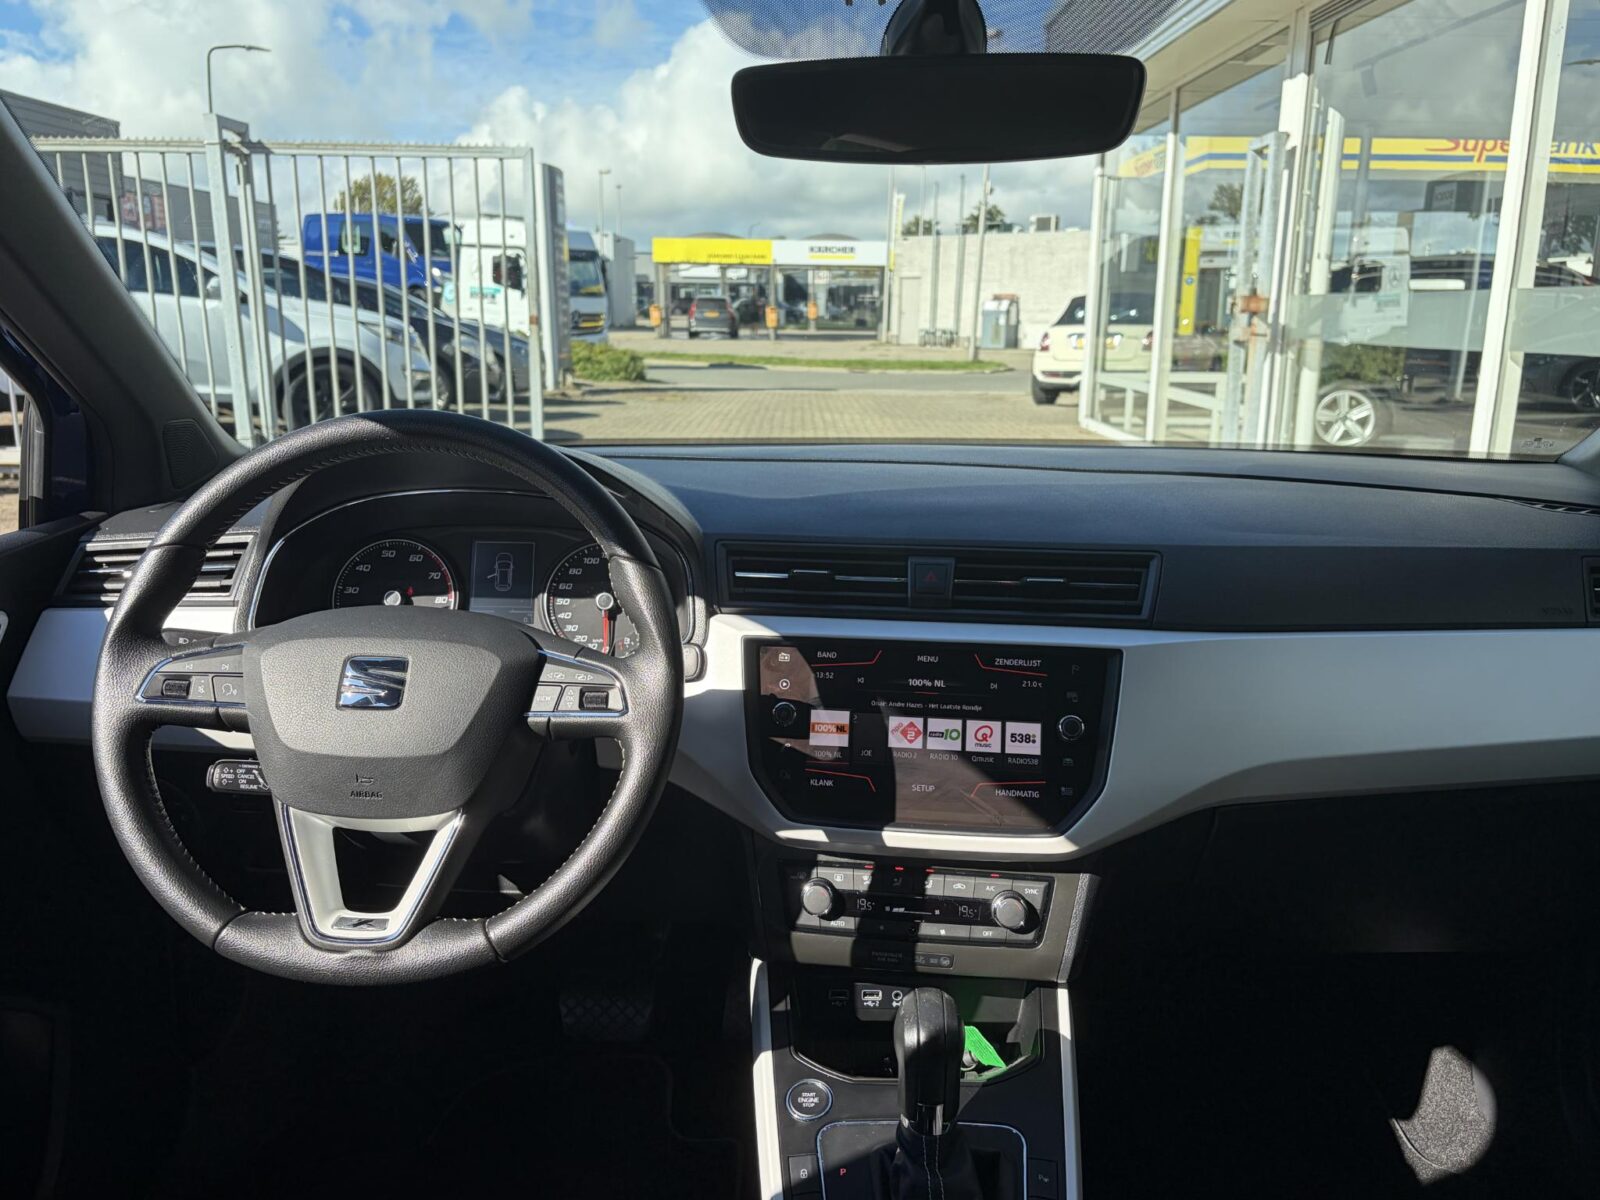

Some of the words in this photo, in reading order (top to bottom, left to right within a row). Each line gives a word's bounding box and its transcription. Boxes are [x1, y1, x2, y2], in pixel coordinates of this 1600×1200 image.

[381, 550, 396, 558] 50
[356, 564, 371, 572] 40
[428, 572, 441, 580] 70
[817, 651, 837, 659] BAND
[917, 655, 939, 663] MENU
[995, 658, 1042, 667] ZENDERLIJST
[816, 672, 834, 680] 13:52
[908, 679, 933, 688] 100%
[934, 680, 946, 688] NL
[944, 729, 960, 741] 10
[861, 749, 873, 757] JOE
[971, 755, 995, 763] Qmusic
[810, 779, 834, 787] KLANK
[912, 784, 935, 792] SETUP
[350, 791, 384, 799] AIRBAG
[995, 789, 1040, 798] HANDMATIG
[830, 920, 845, 928] AUTO
[840, 1168, 847, 1176] P
